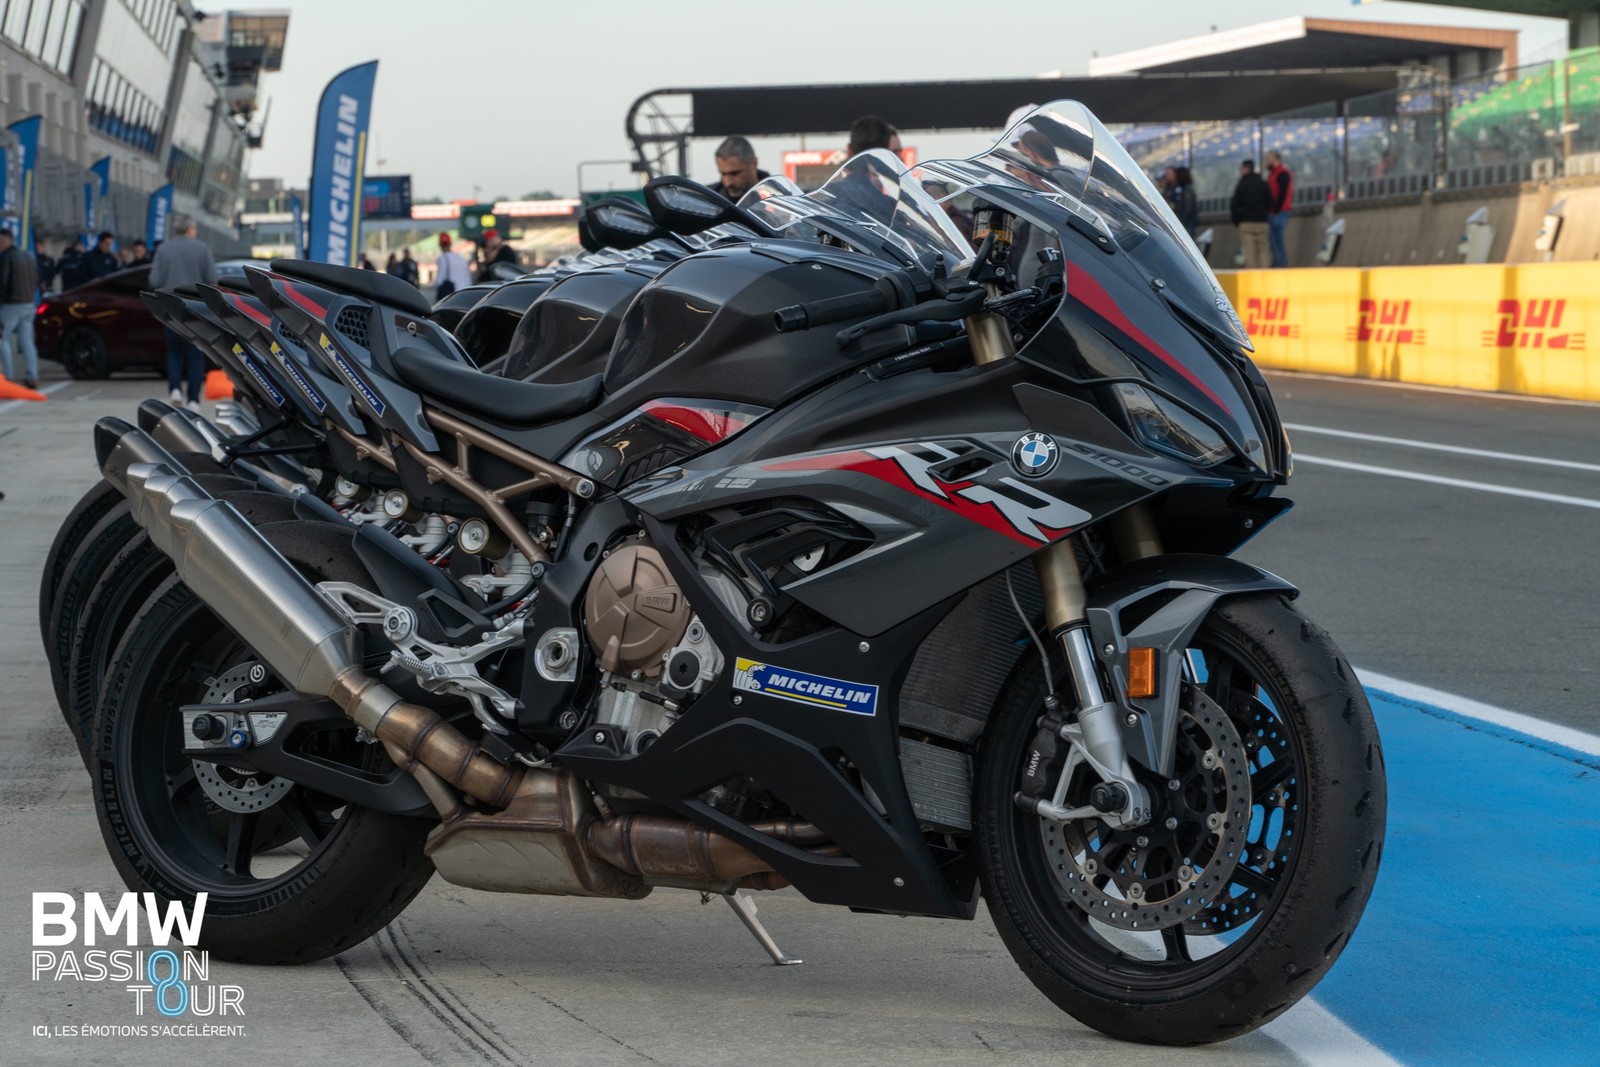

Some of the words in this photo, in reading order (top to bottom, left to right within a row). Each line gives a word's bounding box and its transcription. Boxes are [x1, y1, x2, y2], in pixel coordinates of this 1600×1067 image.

[326, 94, 358, 266] MICHELIN
[1247, 297, 1291, 337] DHL
[1357, 299, 1415, 344] DHL
[1496, 299, 1570, 348] DHL
[247, 363, 278, 398] MICHELIN
[285, 363, 320, 404] MICHELIN
[338, 359, 377, 406] MICHELIN
[1020, 433, 1056, 450] BMW
[645, 596, 670, 606] BMW
[104, 696, 118, 752] 190/55
[114, 673, 126, 694] ZR
[123, 652, 133, 670] 17
[768, 674, 871, 704] MICHELIN
[1027, 750, 1041, 777] BMW
[103, 768, 138, 856] MICHELIN
